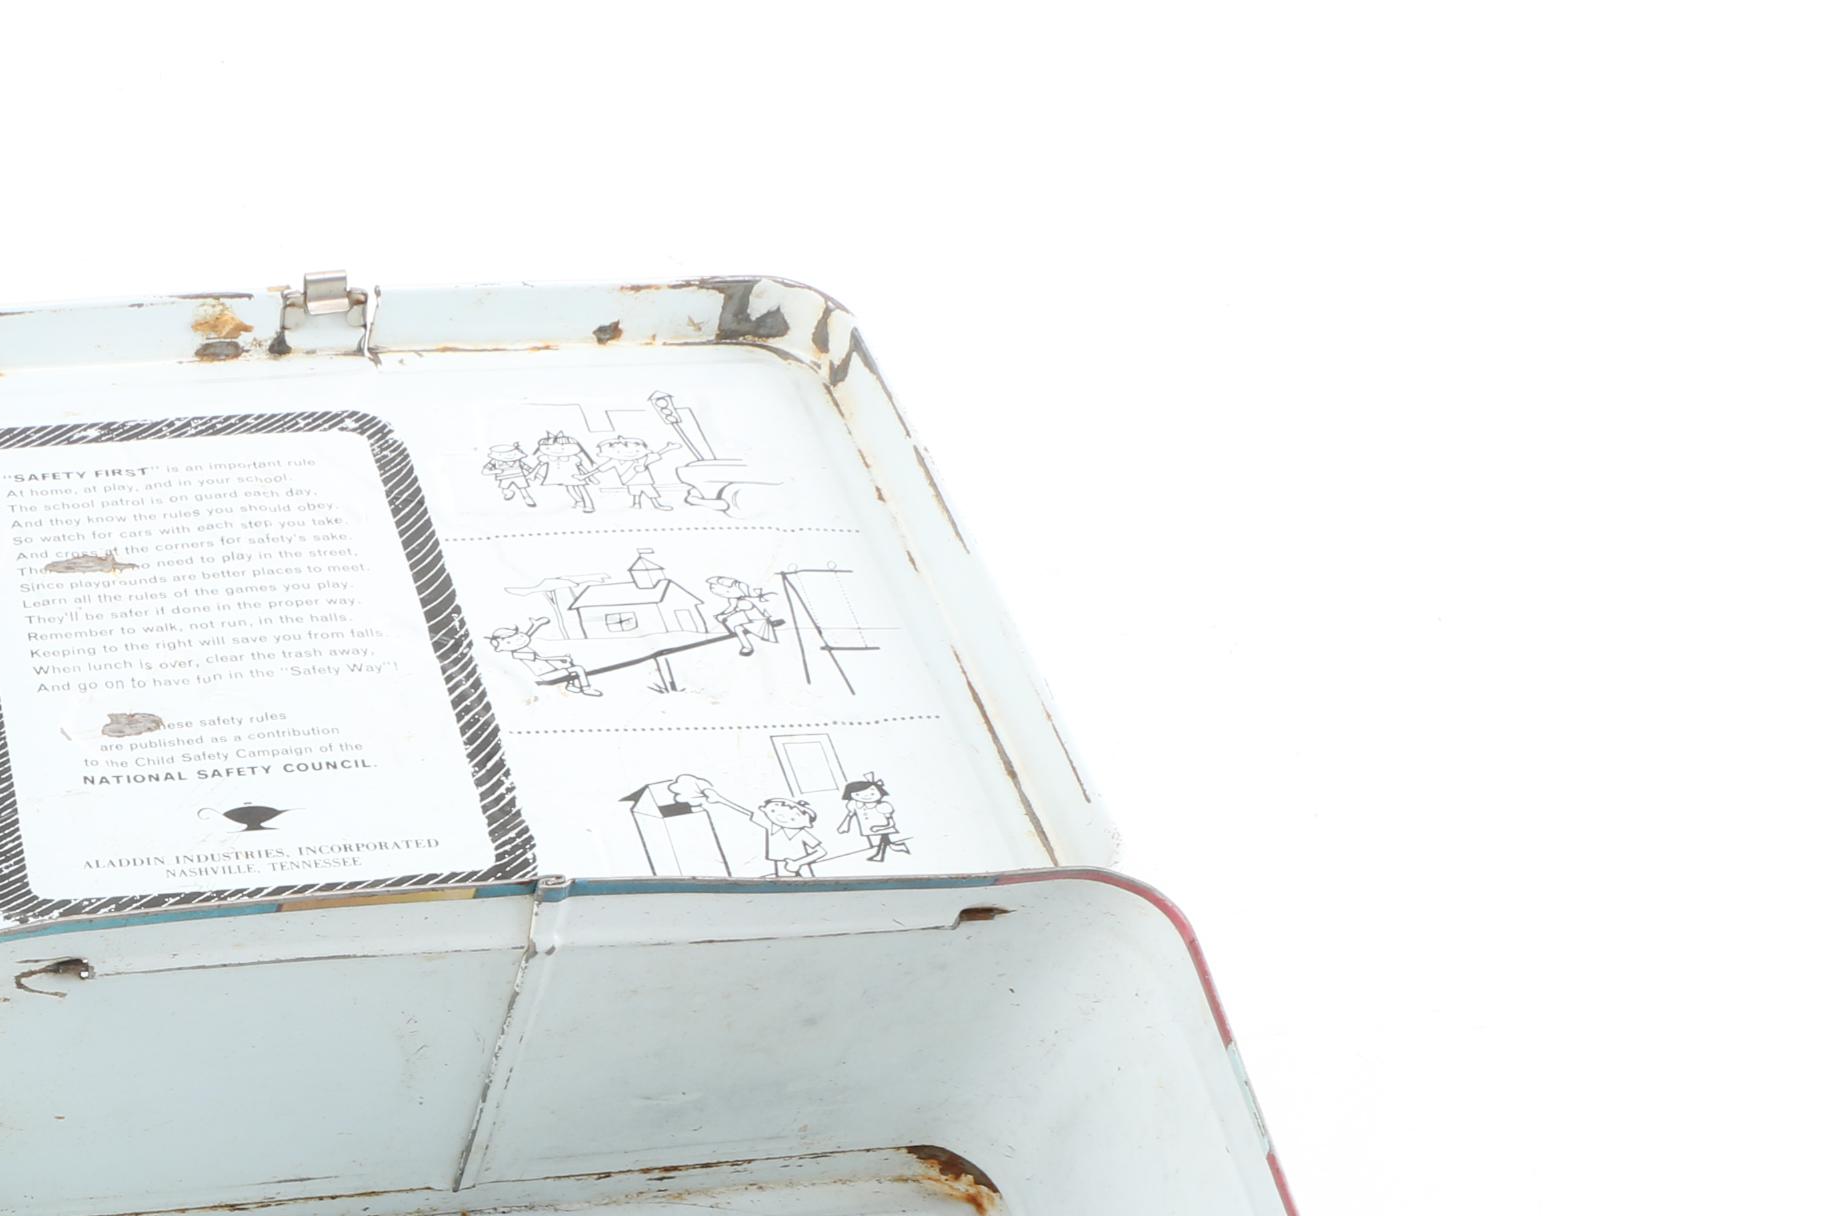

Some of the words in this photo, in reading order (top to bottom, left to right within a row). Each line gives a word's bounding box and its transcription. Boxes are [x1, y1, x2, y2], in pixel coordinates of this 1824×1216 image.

[166, 465, 179, 473] is
[208, 459, 281, 471] important
[287, 458, 316, 466] rule
[22, 598, 68, 609] Learn
[73, 594, 92, 604] all
[97, 592, 122, 604] the
[128, 591, 168, 602] rules
[173, 587, 188, 598] of
[194, 587, 219, 597] the
[224, 584, 277, 596] games
[282, 583, 311, 593] you
[84, 612, 104, 621] be
[110, 608, 148, 619] safer
[155, 605, 165, 616] if
[171, 604, 211, 615] done
[216, 604, 232, 612] in
[236, 600, 262, 610] the
[268, 598, 319, 610] proper
[26, 628, 114, 642] Remember
[120, 626, 136, 635] to
[189, 620, 215, 630] not
[258, 616, 273, 625] in
[278, 614, 304, 624] the
[32, 664, 82, 676] When
[87, 659, 133, 672] lunch
[139, 658, 153, 671] is
[205, 653, 245, 664] clear
[250, 650, 276, 661] the
[281, 647, 323, 659] trash
[36, 680, 71, 693] And
[77, 681, 98, 694] go
[104, 679, 125, 690] on
[130, 676, 147, 689] to
[152, 677, 190, 687] have
[196, 673, 223, 684] fun
[228, 671, 244, 680] in
[249, 668, 274, 679] the
[199, 715, 244, 728] safety
[249, 711, 287, 724] rules
[100, 743, 124, 752] are
[129, 735, 204, 752] published
[210, 735, 228, 744] as
[247, 726, 340, 740] contribution
[83, 758, 100, 768] to
[105, 759, 129, 768] the
[134, 754, 175, 768] Child
[180, 750, 229, 763] Safety
[235, 746, 313, 759] Campaign
[319, 742, 334, 753] of
[338, 742, 363, 752] the
[82, 770, 188, 786] NATIONAL
[196, 764, 272, 781] SAFETY
[83, 856, 166, 870] ALADDIN
[297, 838, 440, 856] INCORPORATED
[267, 856, 362, 872] TENNESSEE
